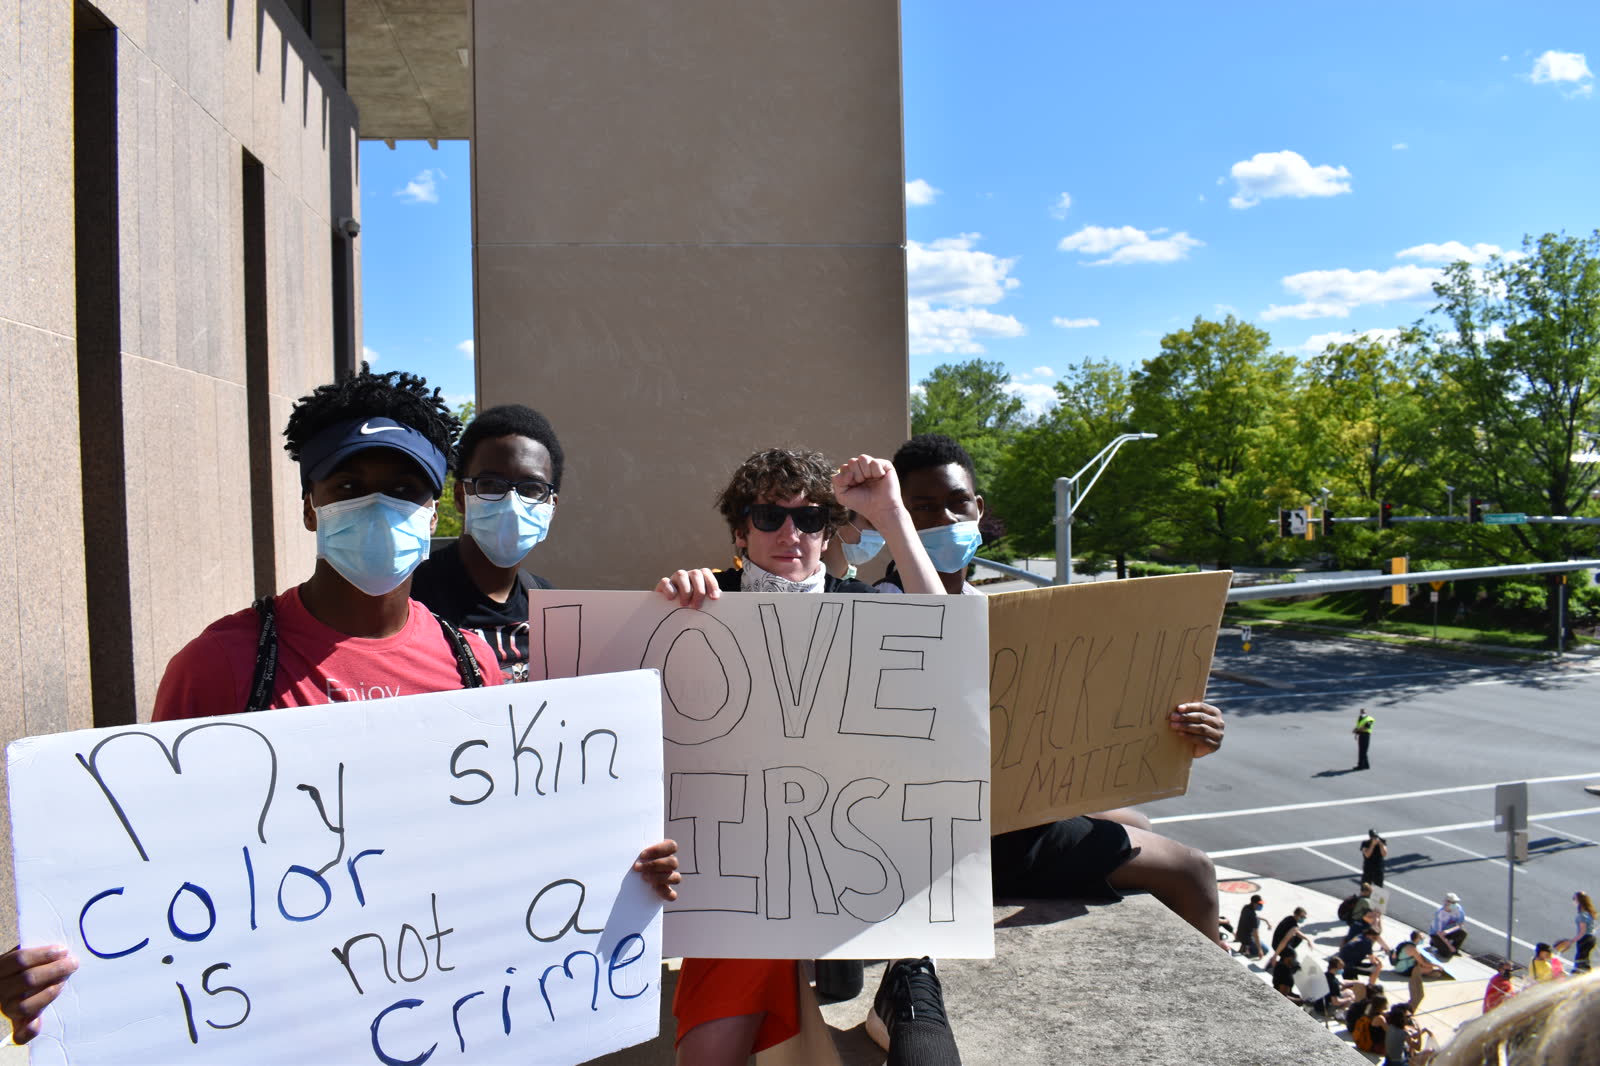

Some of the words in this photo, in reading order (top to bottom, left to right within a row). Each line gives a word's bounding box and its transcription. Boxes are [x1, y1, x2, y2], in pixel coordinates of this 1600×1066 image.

[989, 635, 1114, 770] BLACK
[75, 721, 346, 875] My
[1017, 734, 1160, 814] MATTER
[78, 845, 385, 959] color
[663, 765, 989, 924] IRST
[161, 954, 251, 1044] is
[331, 892, 455, 995] not
[525, 878, 604, 943] a
[370, 932, 650, 1066] crime
